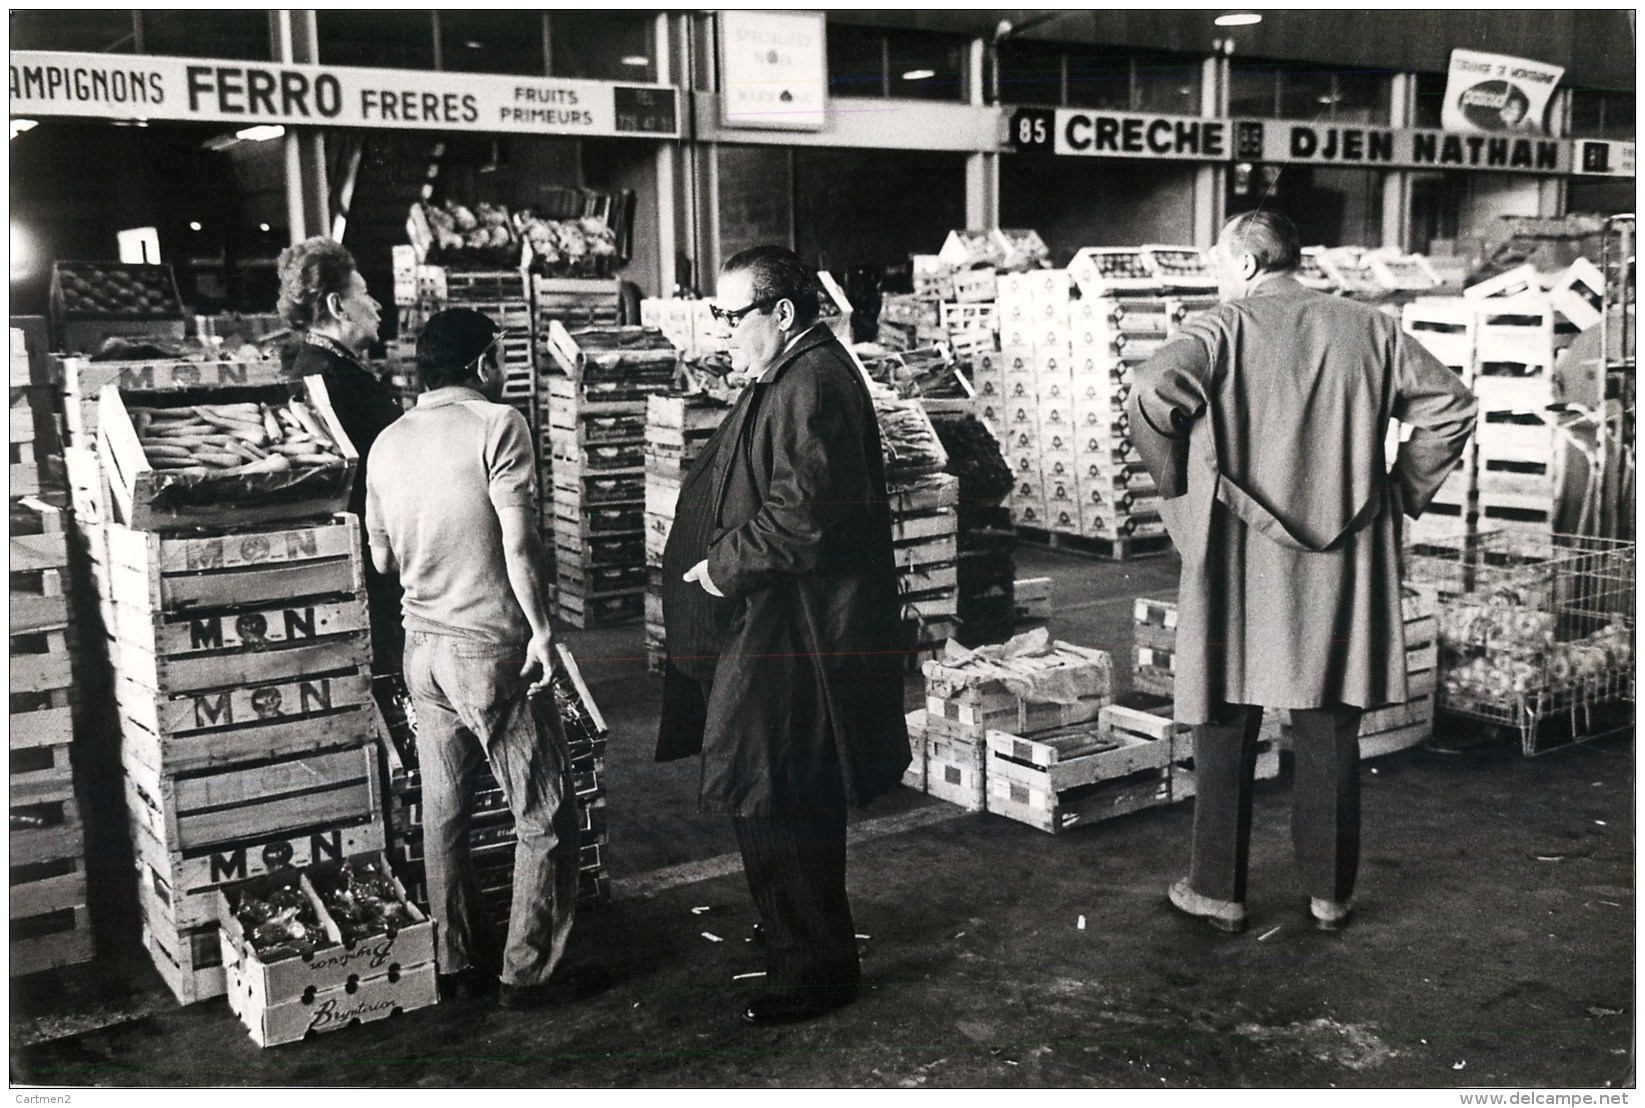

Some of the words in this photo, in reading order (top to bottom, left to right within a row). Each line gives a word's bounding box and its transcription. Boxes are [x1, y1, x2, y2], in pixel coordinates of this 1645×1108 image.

[186, 66, 342, 118] FERRO
[360, 89, 479, 123] FRERES
[514, 87, 578, 104] FRUITS
[500, 107, 593, 126] PRIMEURS
[1019, 117, 1046, 143] 85
[1065, 115, 1224, 155] CRECHE
[1290, 127, 1393, 161] DJEN
[1413, 133, 1558, 168] NATHAN
